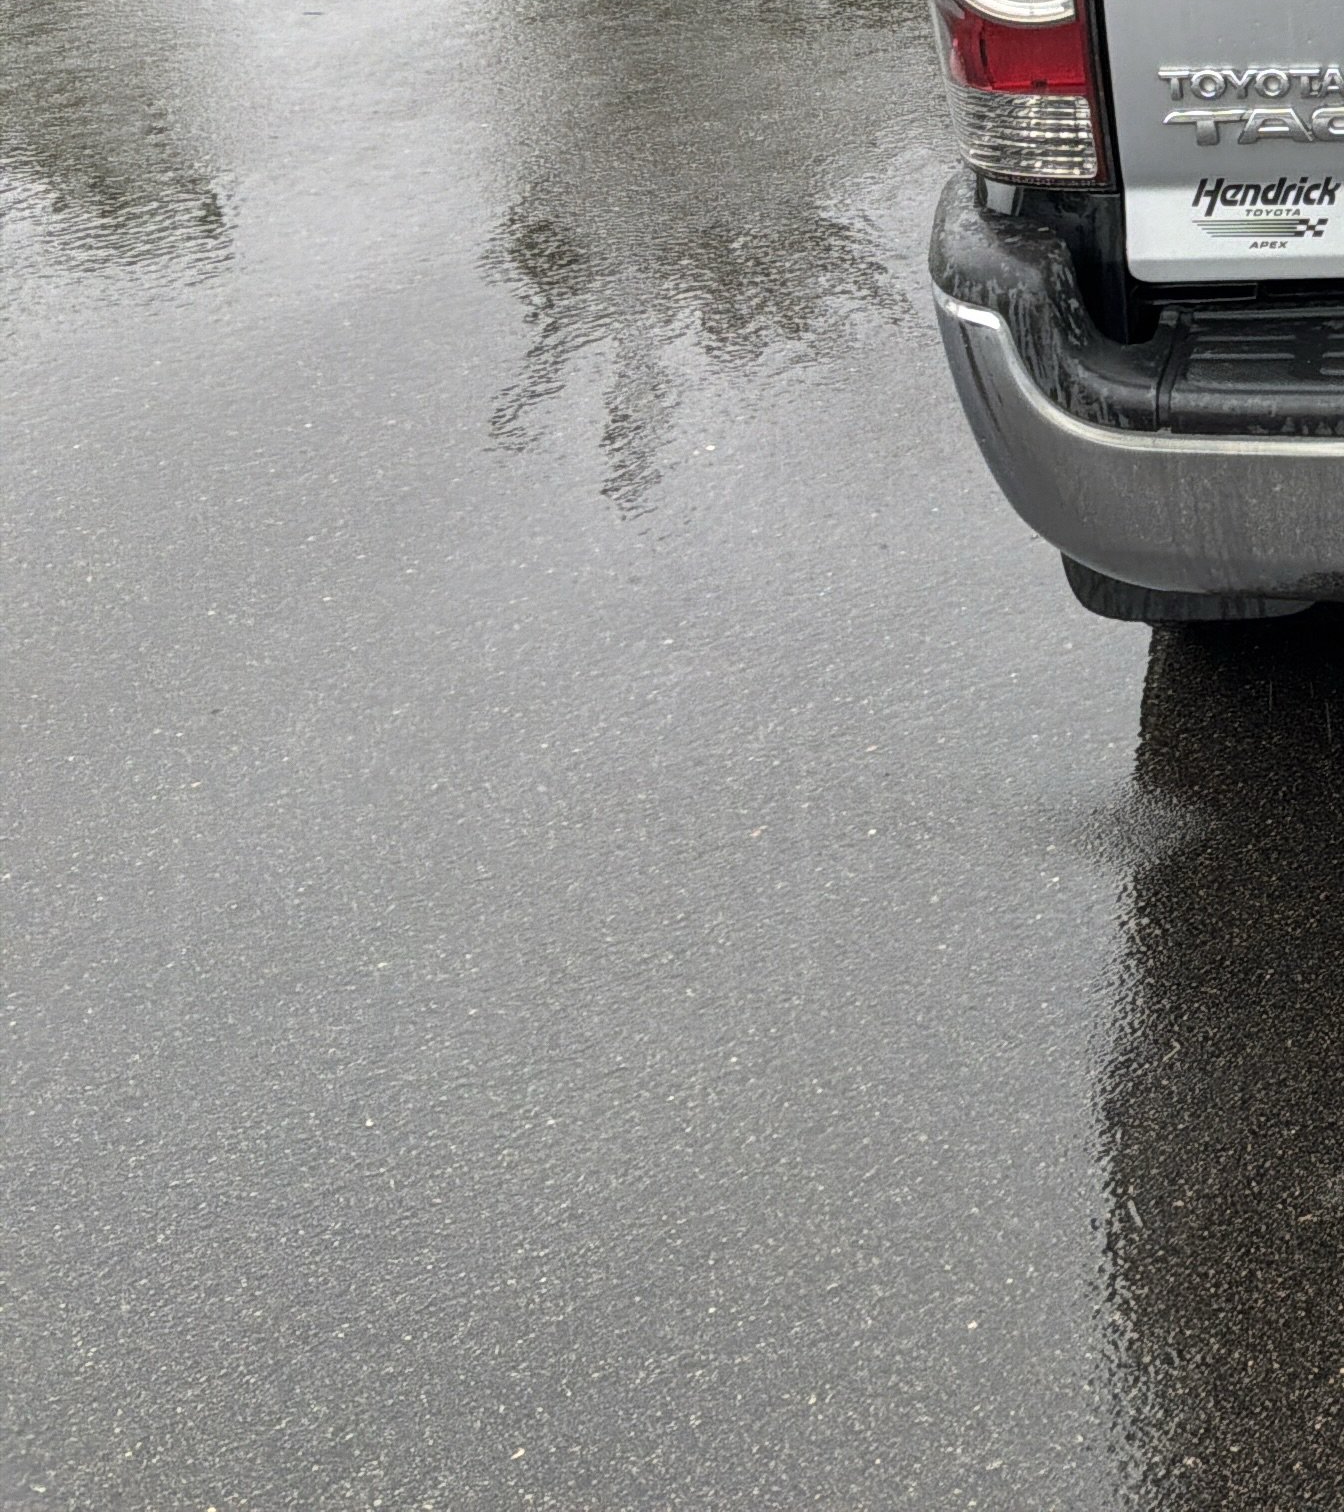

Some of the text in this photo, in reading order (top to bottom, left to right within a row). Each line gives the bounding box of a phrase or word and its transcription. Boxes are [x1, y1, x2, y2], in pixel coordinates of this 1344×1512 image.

[1192, 176, 1342, 217] Hendrick
[1244, 208, 1301, 217] TOYOTA
[1249, 240, 1288, 250] APEX
